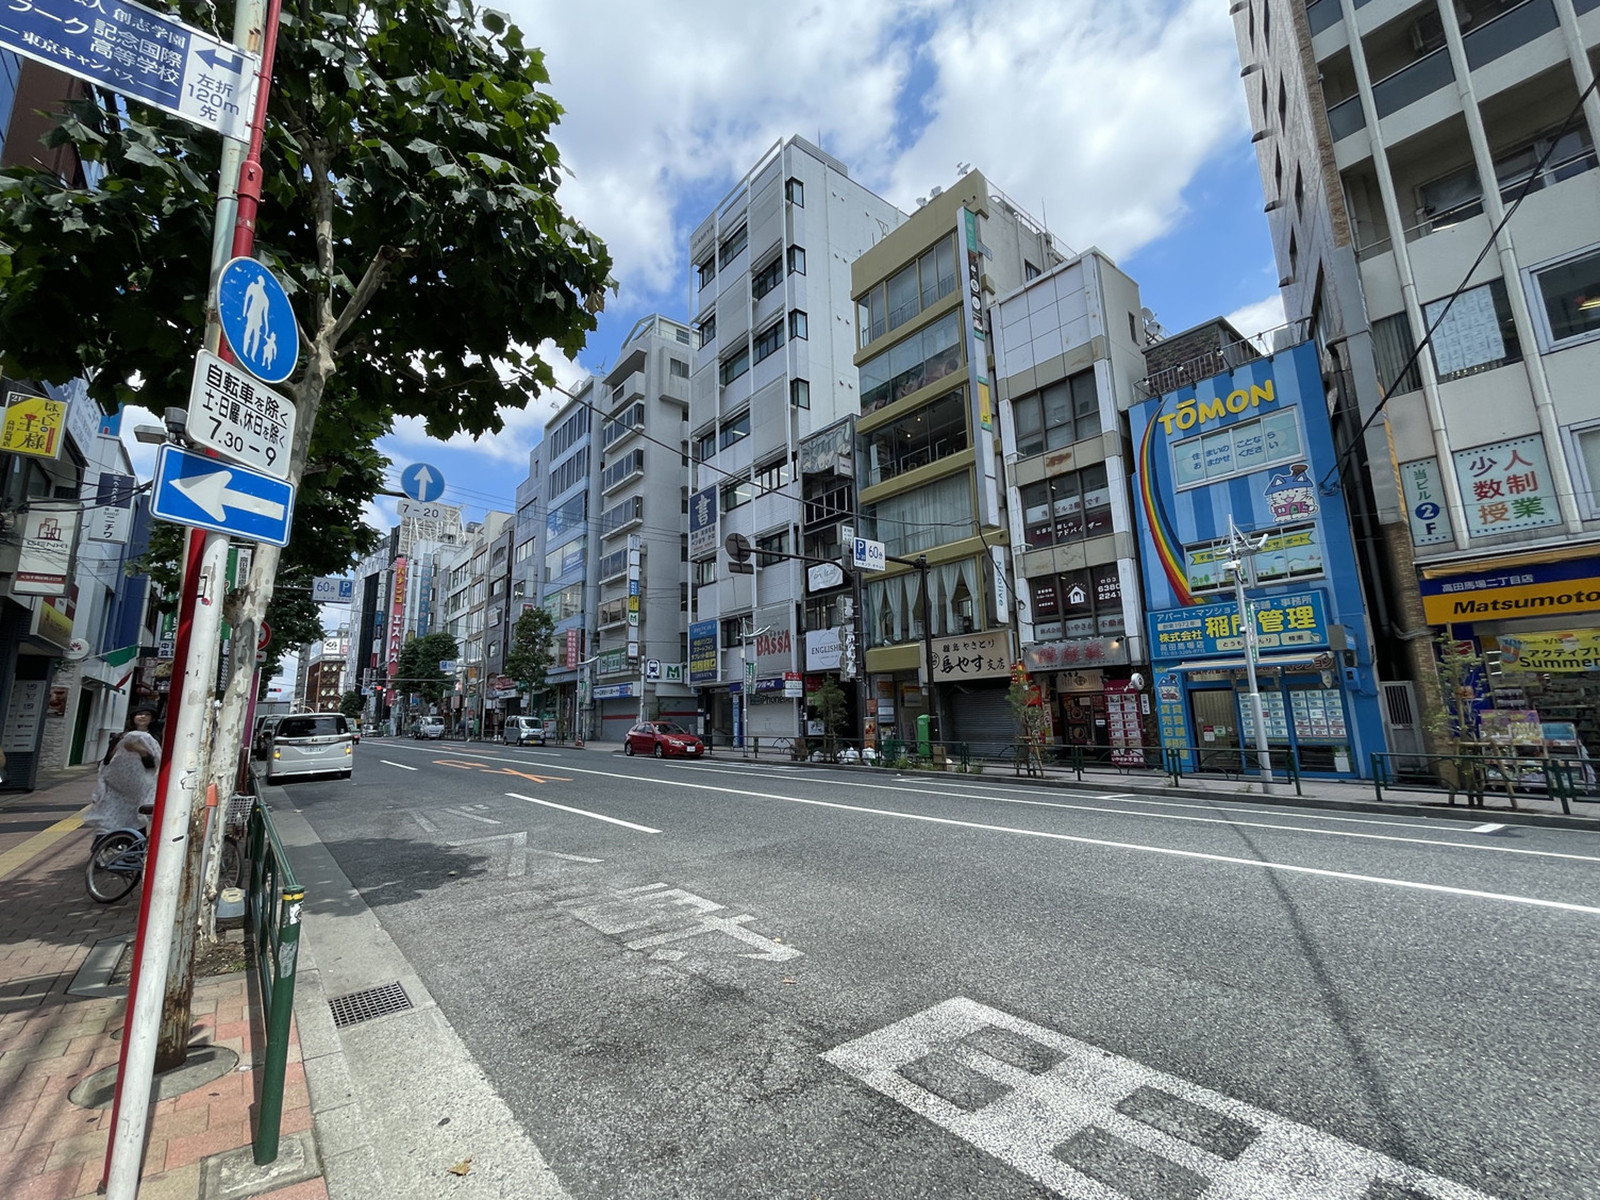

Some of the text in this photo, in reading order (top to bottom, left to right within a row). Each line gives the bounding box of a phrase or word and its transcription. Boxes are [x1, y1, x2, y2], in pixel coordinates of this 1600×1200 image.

[113, 7, 186, 49] 創志学園
[22, 29, 136, 84] 東京キャンパス
[93, 18, 183, 70] 記念国際
[90, 36, 181, 87] 高等学校
[196, 72, 234, 98] 左折
[187, 84, 240, 116] 120m
[200, 104, 218, 122] 先
[206, 363, 289, 426] 自転車を除く
[1191, 431, 1276, 460] 住まいのことなら
[1193, 441, 1279, 470] おまかせください
[1469, 449, 1533, 478] 少人
[1473, 470, 1539, 501] 数制
[1478, 496, 1545, 525] 授業
[858, 541, 865, 552] P
[1442, 574, 1534, 593] 高田馬場二丁目店
[1453, 590, 1600, 614] Matsumoto
[1159, 629, 1203, 643] 株式会社
[1160, 640, 1204, 652] 高田馬場店
[1222, 637, 1273, 649] とうもんり
[986, 658, 1006, 671] 支店
[1519, 656, 1600, 669] Summer
